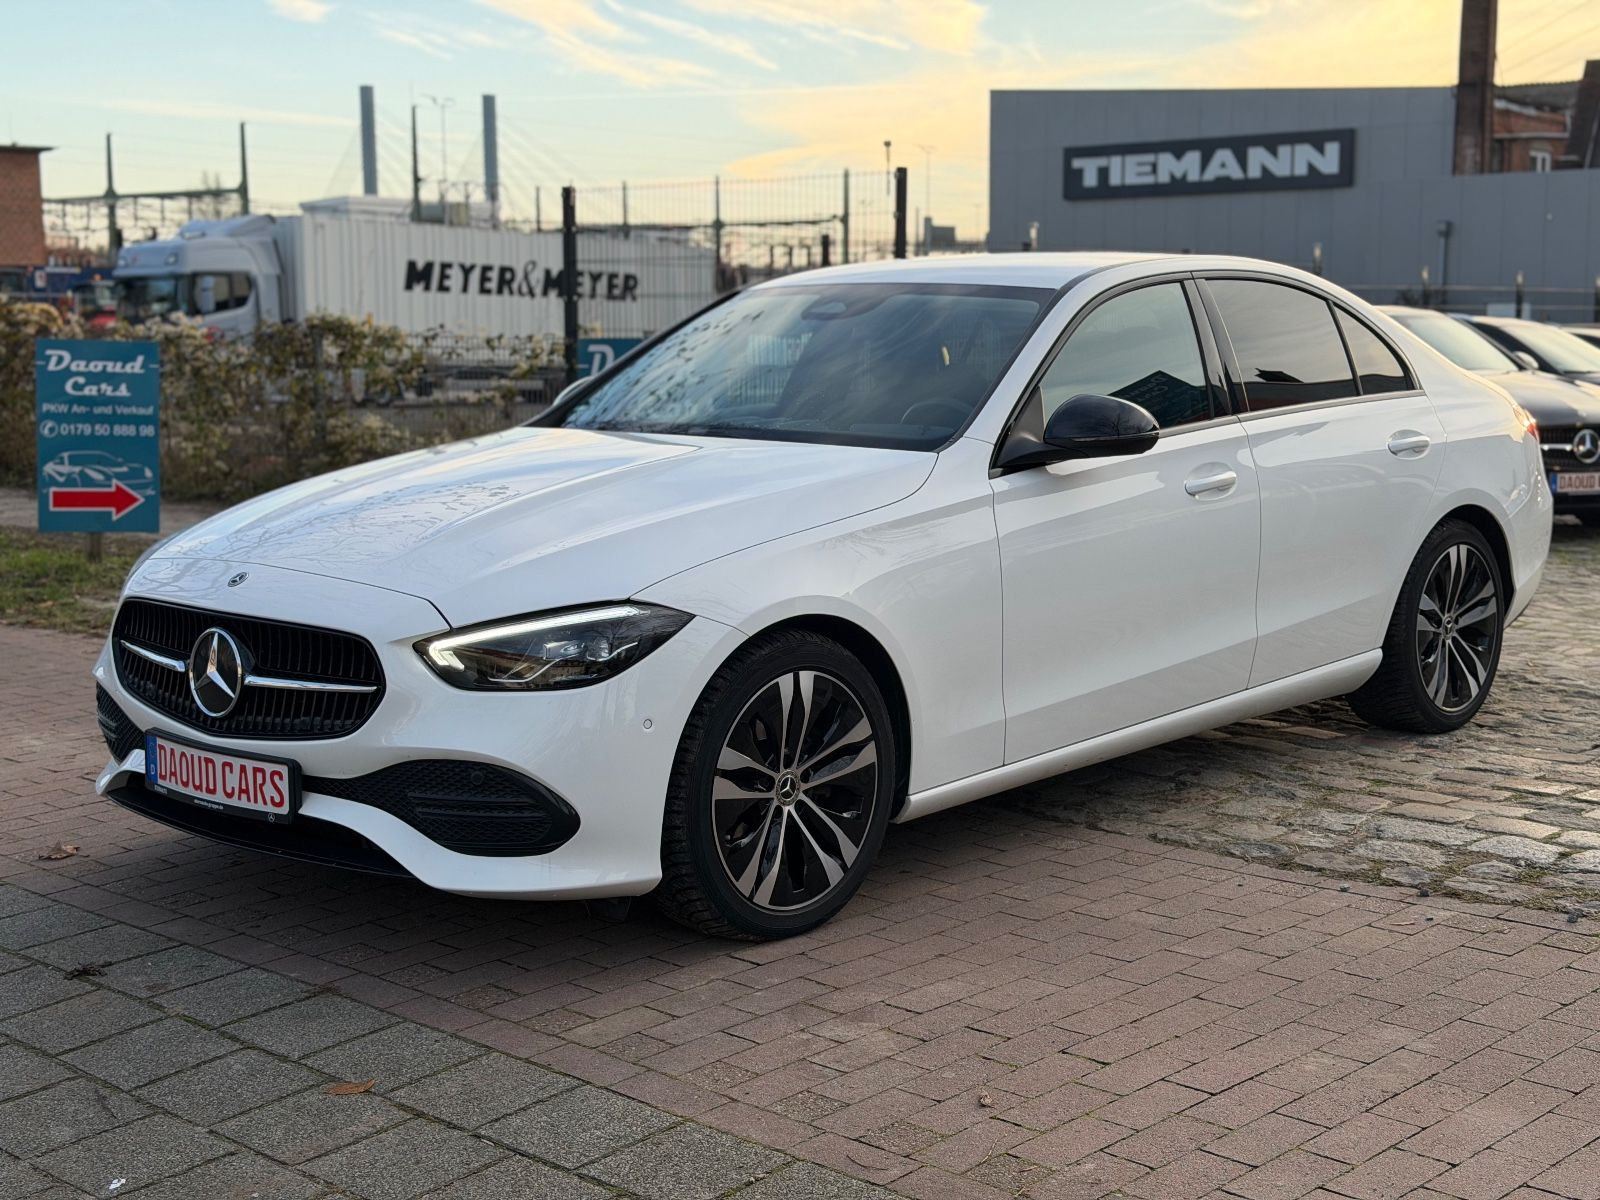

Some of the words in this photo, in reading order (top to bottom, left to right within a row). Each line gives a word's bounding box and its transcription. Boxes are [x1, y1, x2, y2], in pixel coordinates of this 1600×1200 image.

[1071, 141, 1340, 187] TIEMANN
[45, 350, 145, 373] Daoud
[65, 377, 131, 396] Cars
[42, 403, 68, 413] PKW
[71, 404, 90, 414] An-
[93, 405, 113, 414] und
[115, 405, 154, 416] Verkauf
[60, 424, 92, 436] 0179
[94, 424, 110, 436] 50
[1560, 475, 1595, 489] DAOUD
[158, 743, 217, 796] DAOUD
[221, 761, 285, 808] CARS
